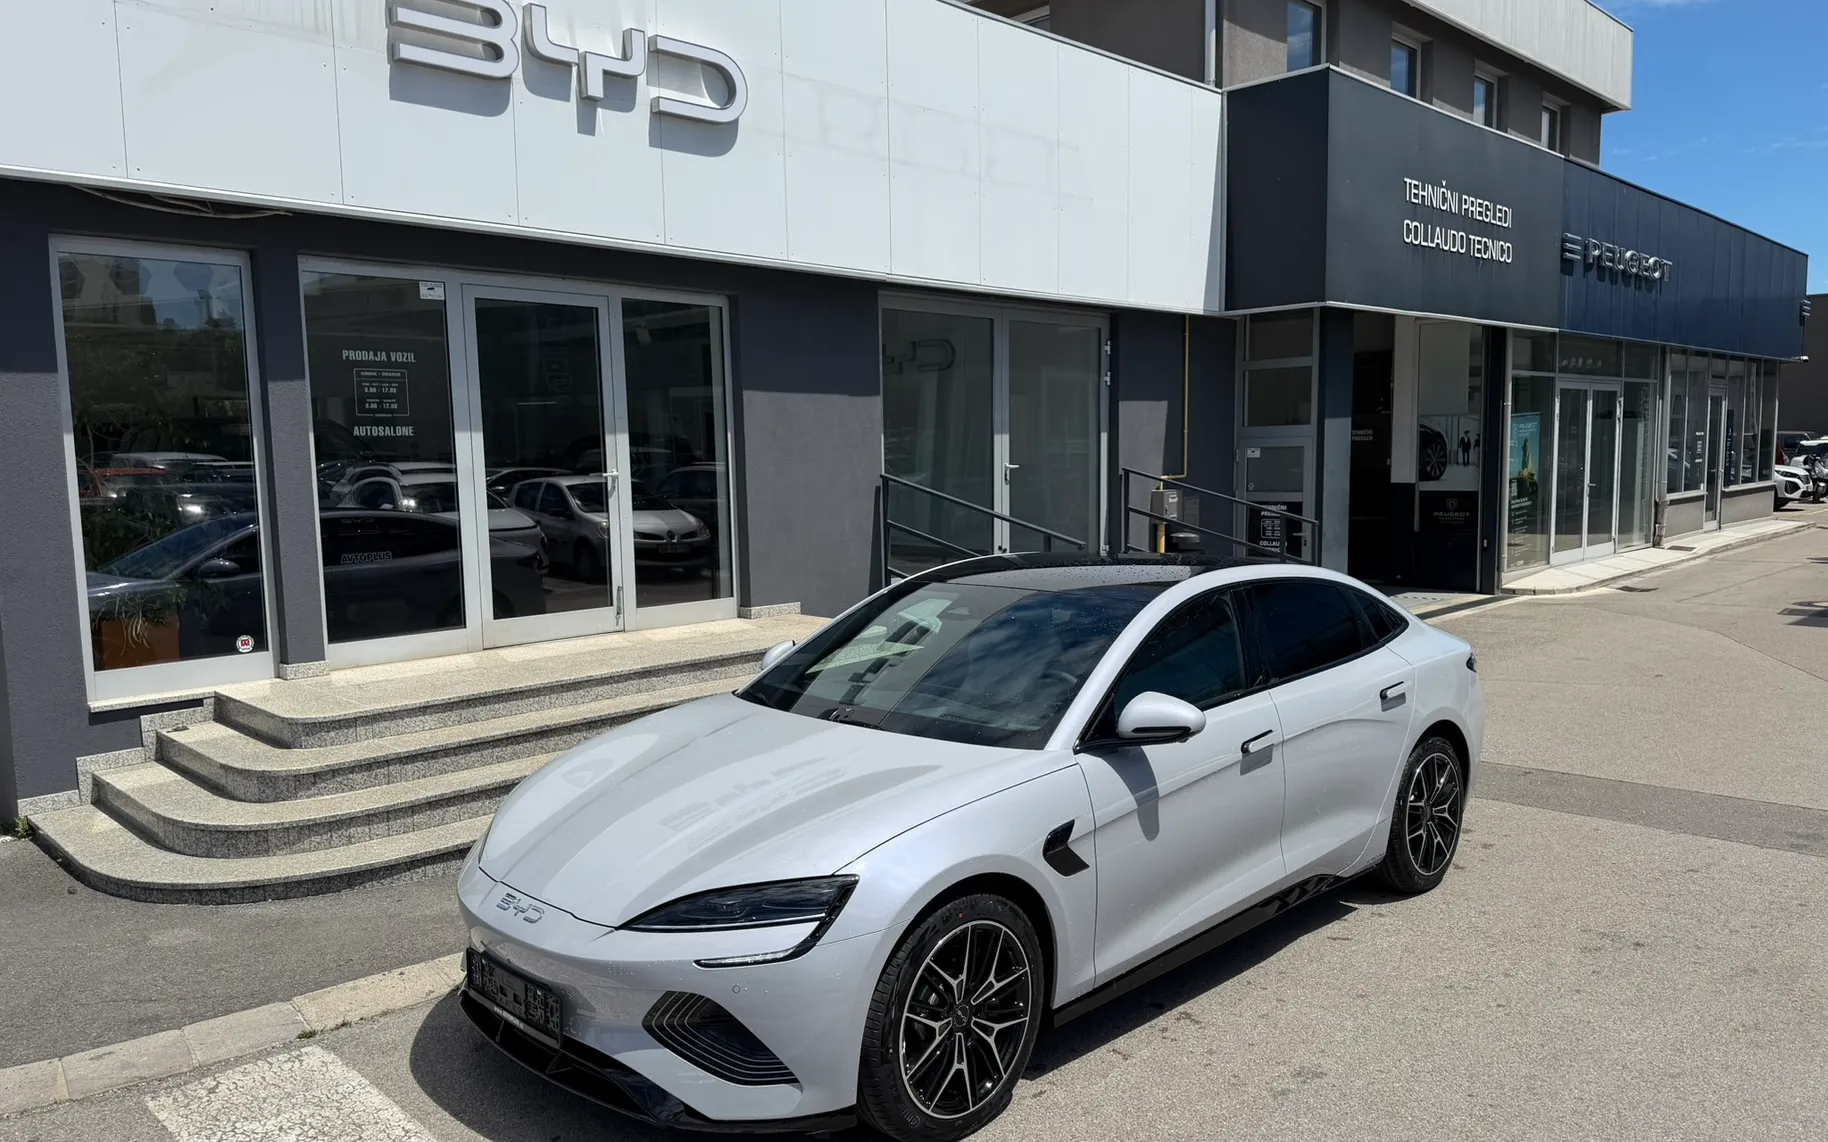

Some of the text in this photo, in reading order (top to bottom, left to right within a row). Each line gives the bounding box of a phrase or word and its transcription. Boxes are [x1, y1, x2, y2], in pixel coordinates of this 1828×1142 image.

[386, 0, 748, 122] BYD
[1404, 177, 1512, 229] TEHNIČNI PREGLEDI
[1403, 219, 1513, 263] COLLAUDO TECNICO
[1585, 238, 1673, 281] PEUGEOT
[342, 350, 416, 362] PRODAJA VOZIL
[353, 425, 414, 436] AUTOSALONE
[341, 551, 393, 564] AVTOPLUS
[496, 892, 545, 924] BYD
